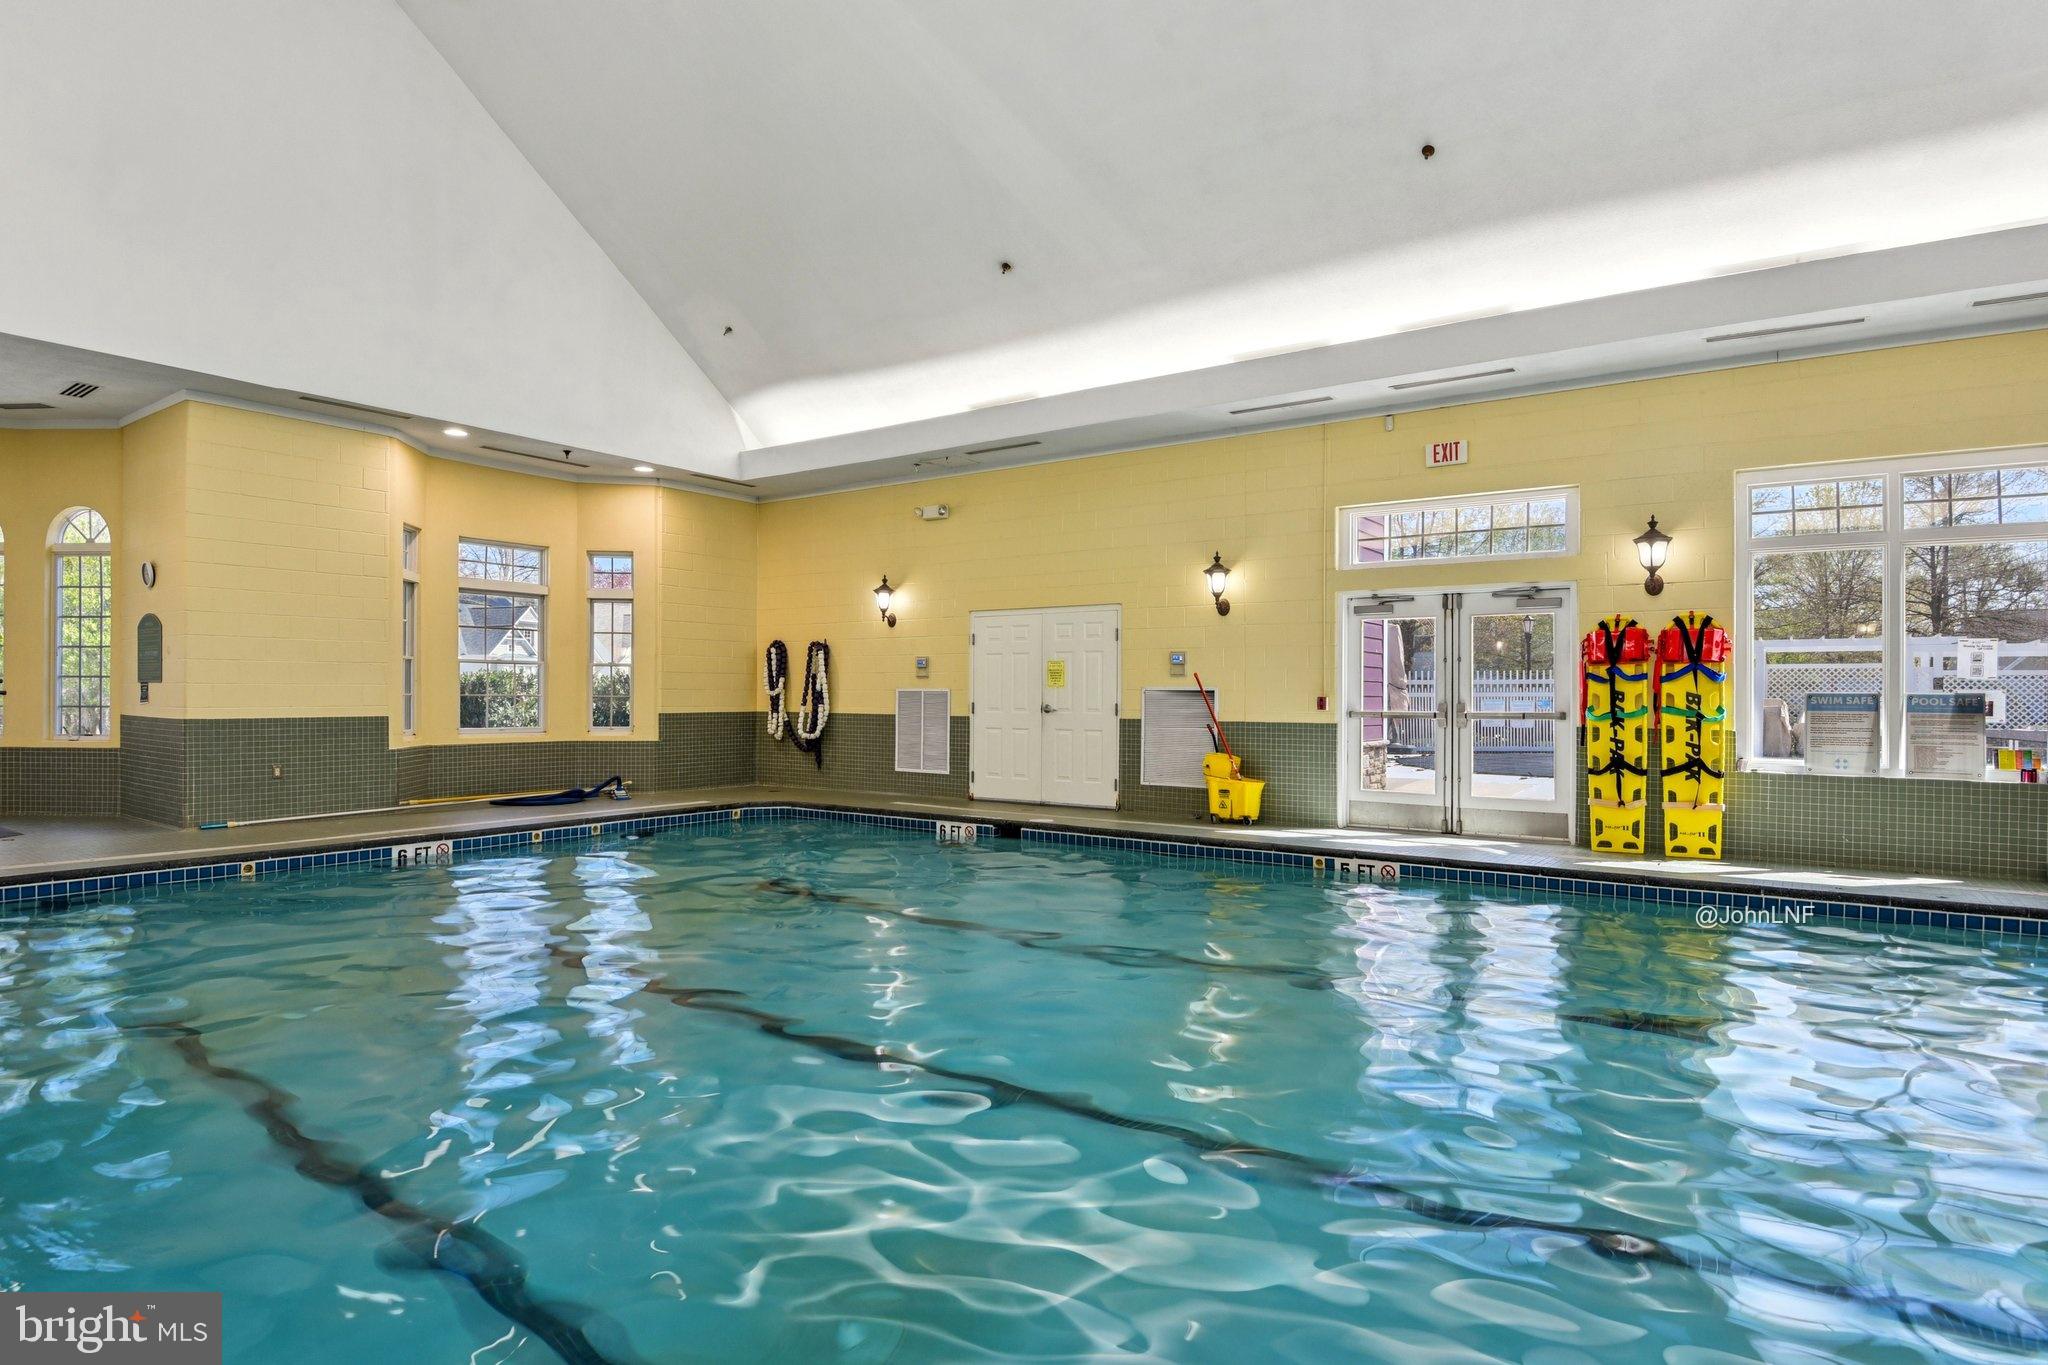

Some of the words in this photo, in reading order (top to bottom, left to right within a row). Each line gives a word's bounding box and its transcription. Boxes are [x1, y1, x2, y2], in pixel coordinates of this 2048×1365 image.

[1433, 441, 1460, 464] EXIT
[1810, 696, 1843, 705] SWIM
[1846, 696, 1874, 705] SAFE
[1911, 697, 1947, 706] POOL
[1948, 697, 1979, 707] SAFE
[940, 824, 946, 840] 6
[951, 825, 962, 842] FT
[415, 845, 432, 864] FT
[1340, 862, 1351, 875] 5
[1357, 863, 1376, 882] FT
